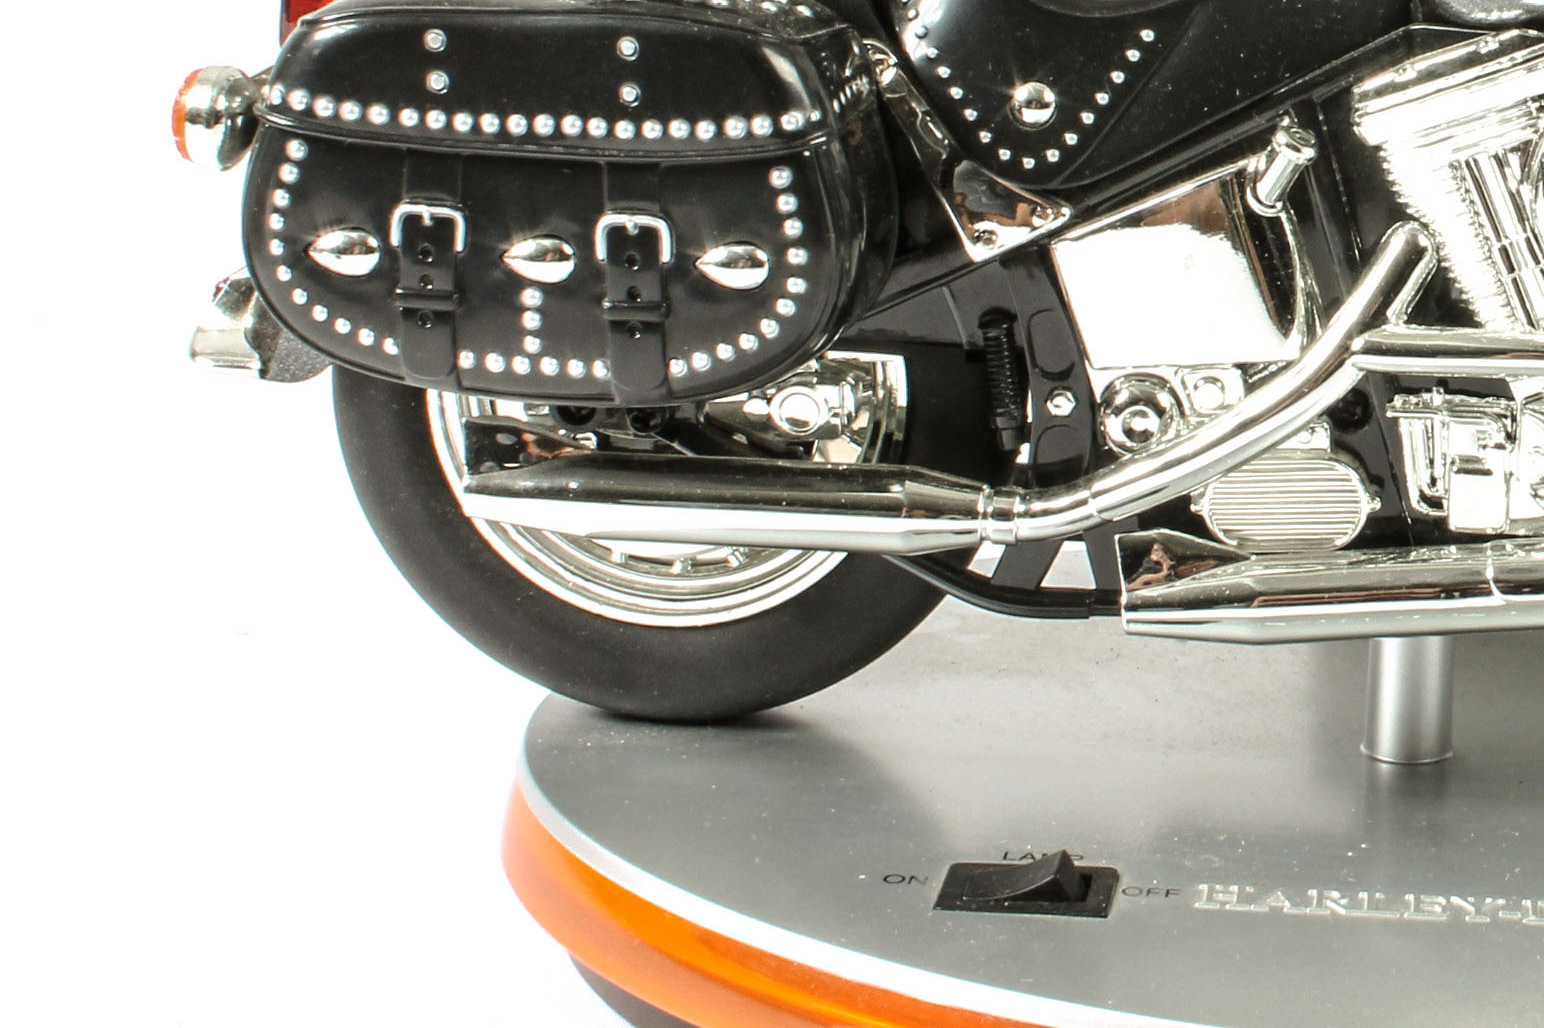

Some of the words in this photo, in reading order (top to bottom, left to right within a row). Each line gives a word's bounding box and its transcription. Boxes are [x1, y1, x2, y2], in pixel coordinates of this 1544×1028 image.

[1002, 851, 1085, 862] LAP
[882, 873, 929, 886] ON
[1120, 886, 1183, 899] OFF
